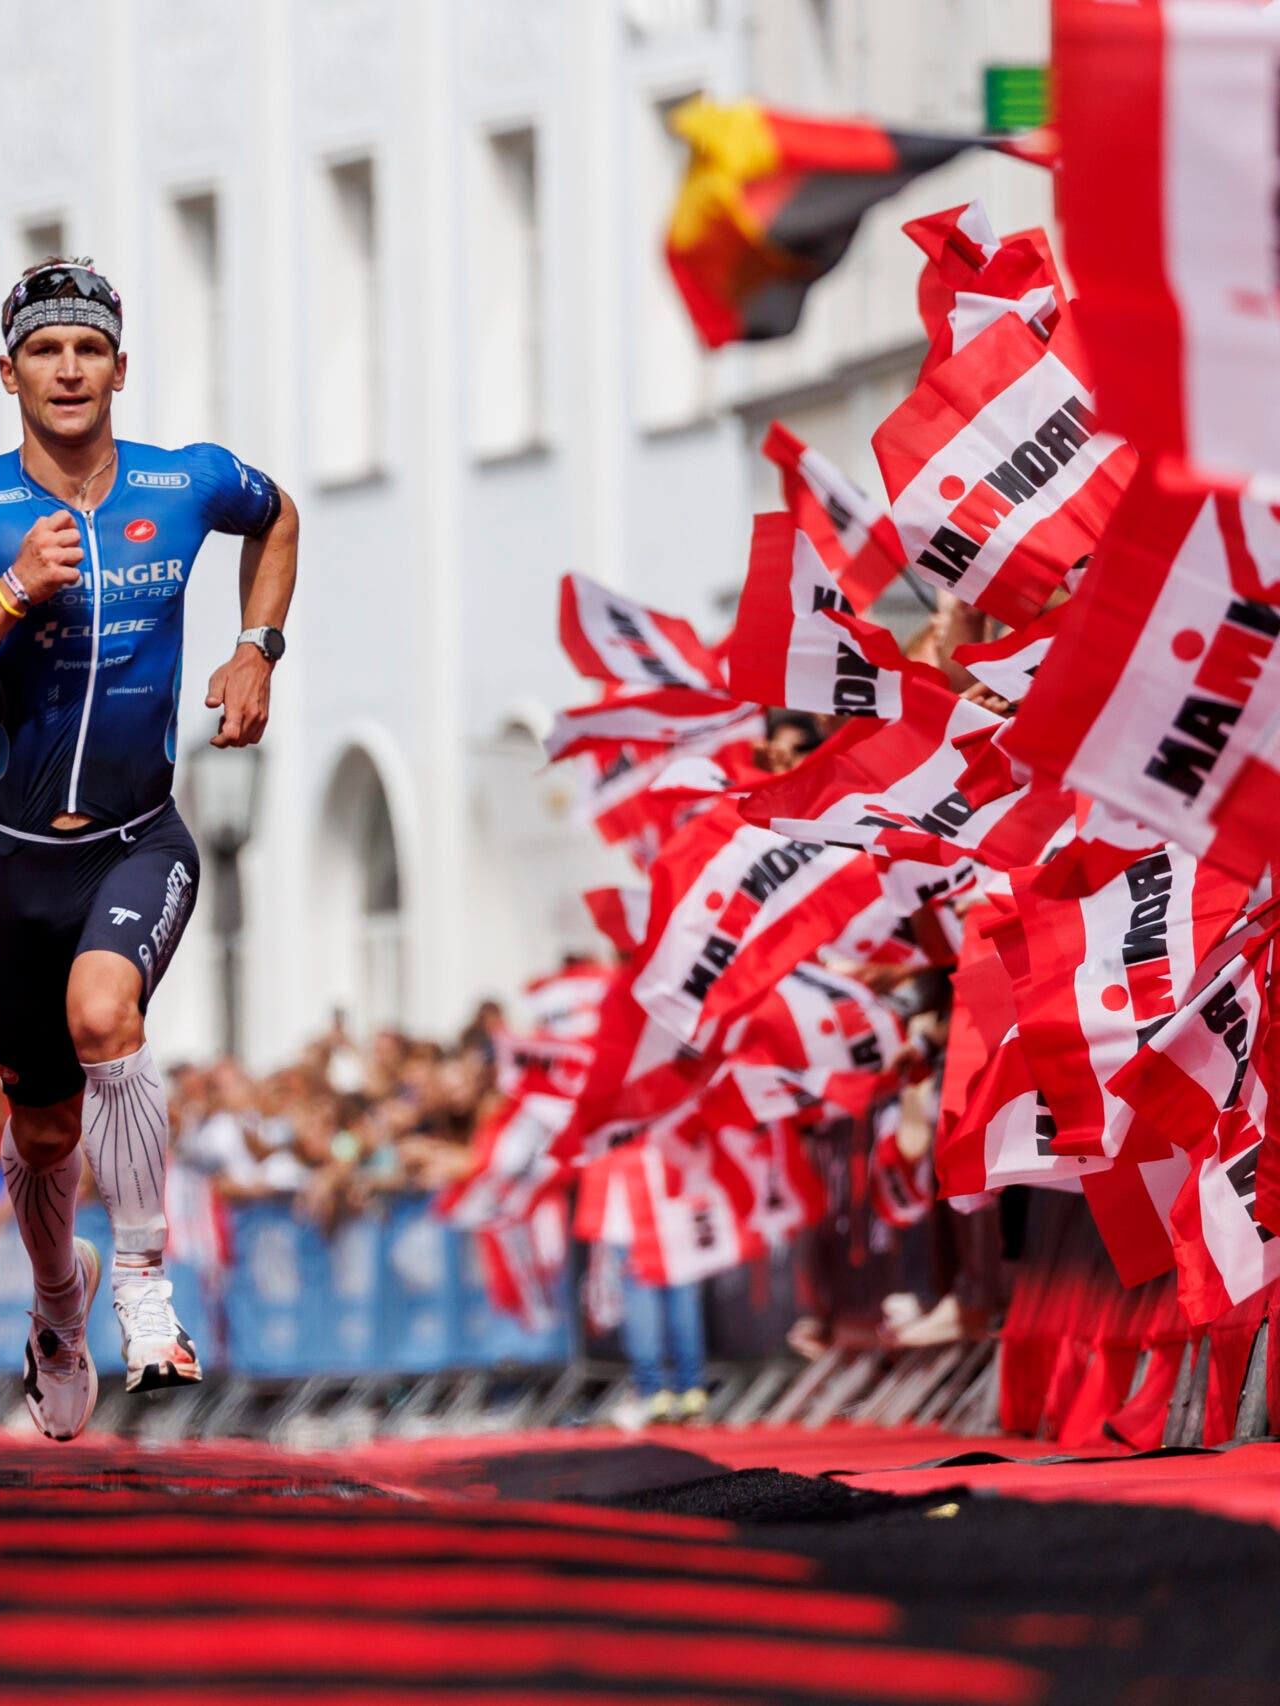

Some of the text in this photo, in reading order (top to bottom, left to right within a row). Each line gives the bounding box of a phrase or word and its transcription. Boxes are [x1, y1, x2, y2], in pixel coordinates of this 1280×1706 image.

[134, 474, 182, 486] ABUS
[60, 618, 159, 639] CUBE
[150, 861, 192, 956] ERDINGER
